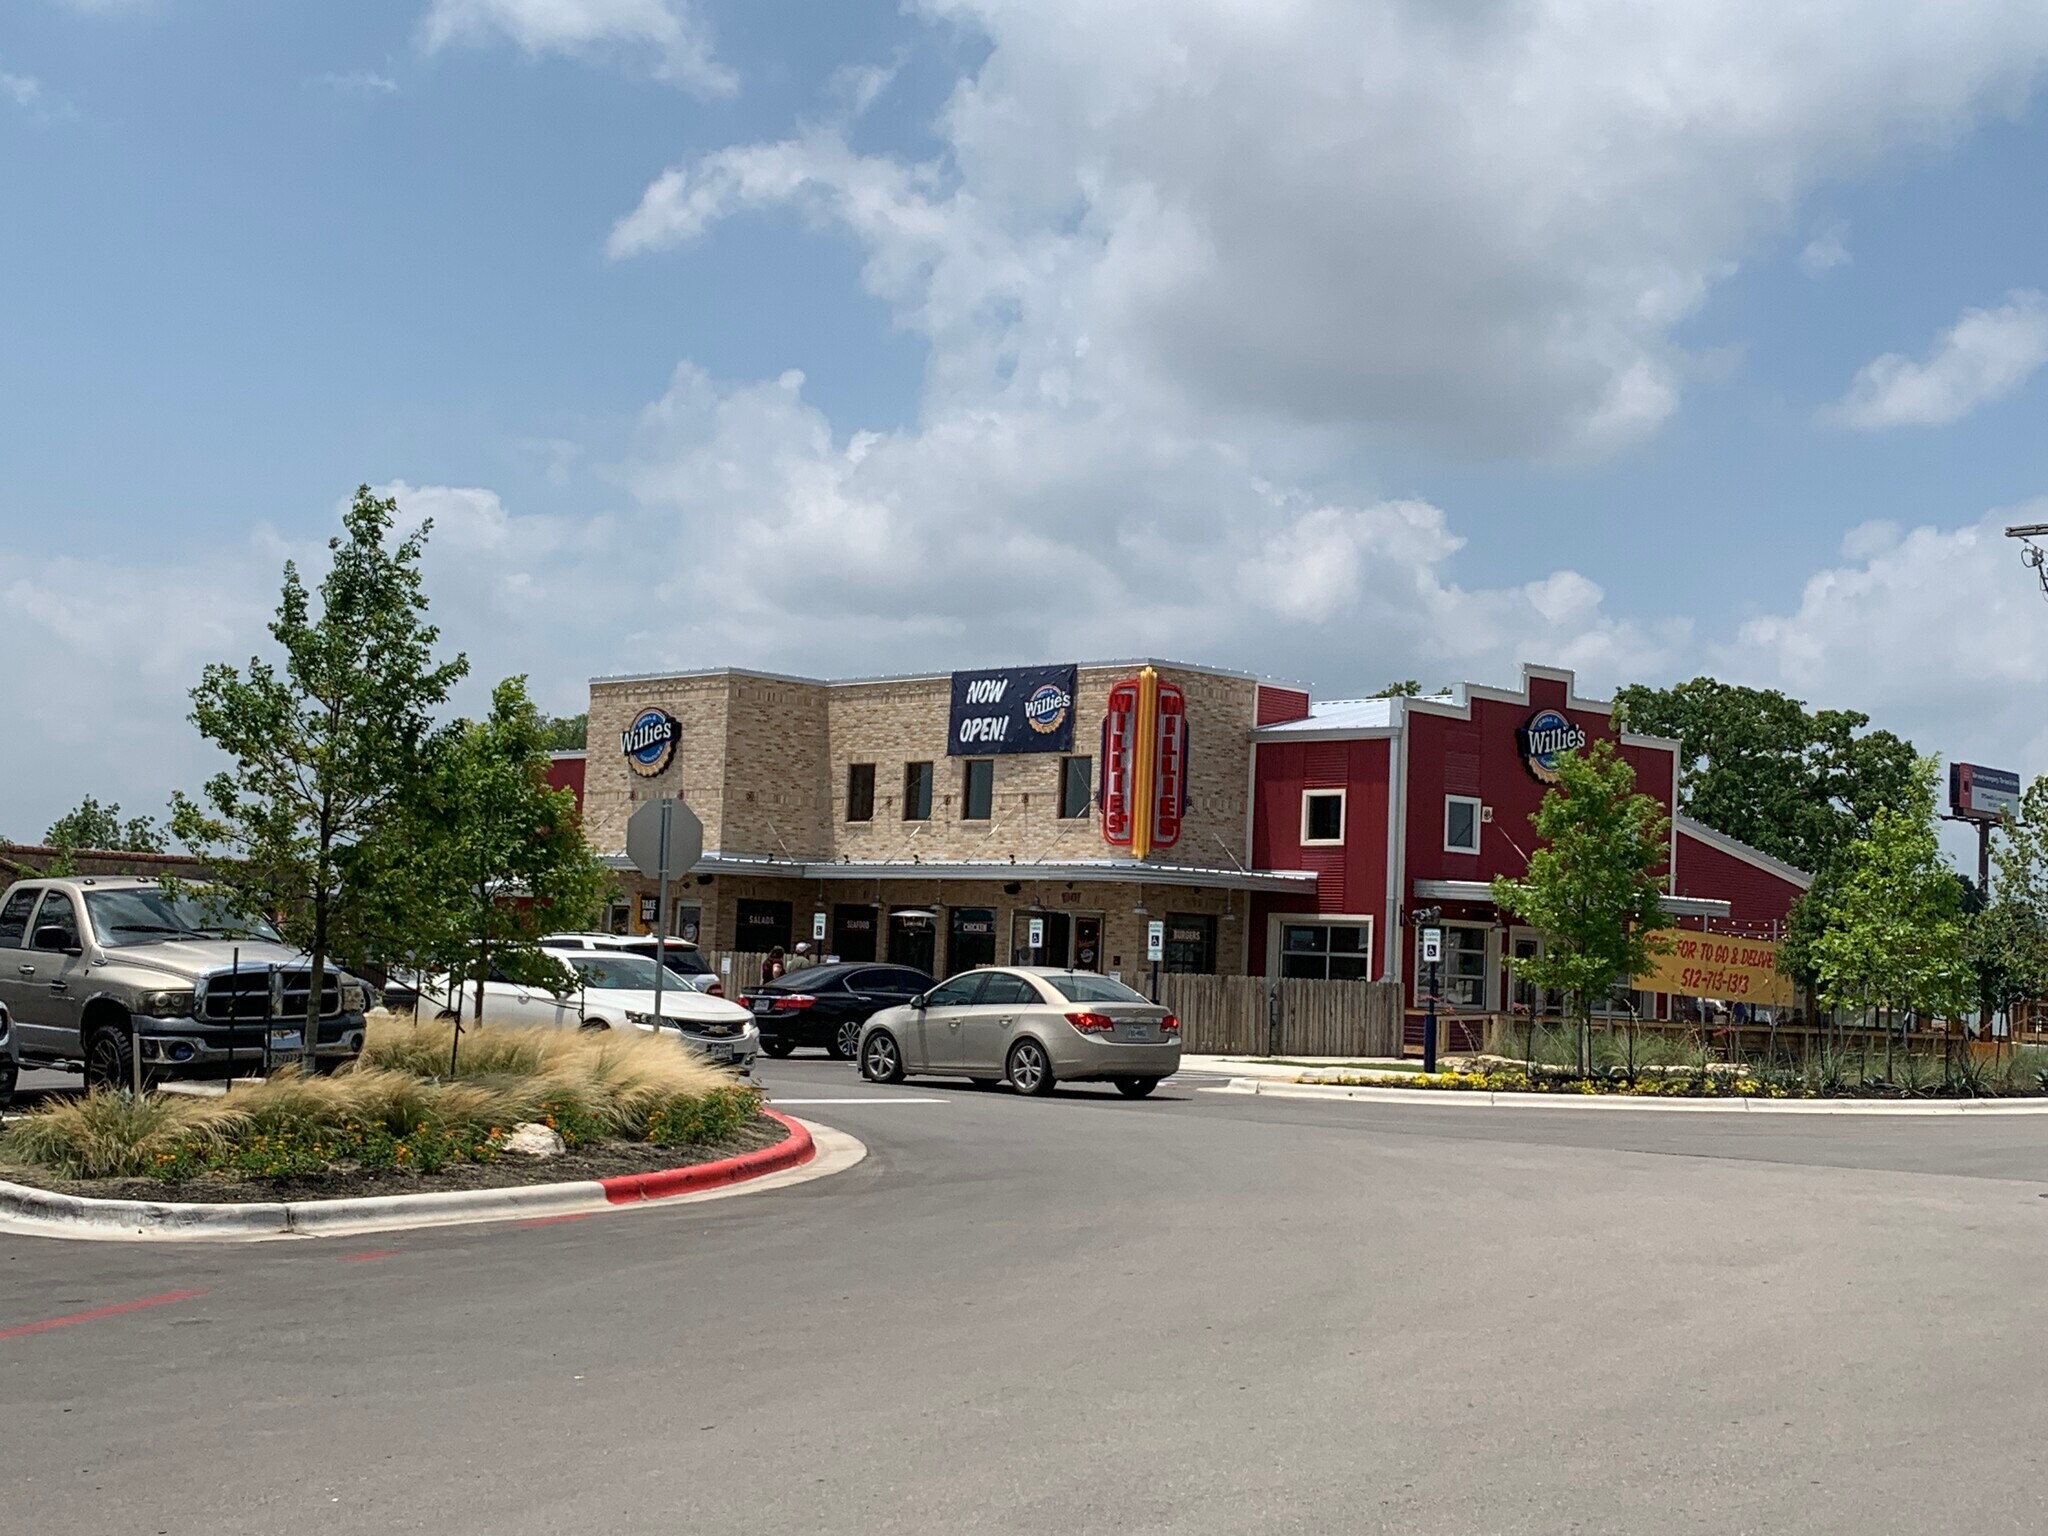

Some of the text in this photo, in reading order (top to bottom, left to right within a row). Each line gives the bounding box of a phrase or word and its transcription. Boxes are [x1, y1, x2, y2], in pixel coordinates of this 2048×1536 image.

[966, 679, 1008, 704] NOW
[1024, 691, 1071, 718] Willie's
[619, 719, 672, 753] Willie's
[960, 715, 1010, 743] OPEN!
[1528, 724, 1586, 755] Willie's
[641, 899, 657, 910] TAKE
[641, 910, 655, 920] OUT
[749, 915, 775, 925] SALADS
[847, 920, 870, 929] SEAFOOD
[1173, 929, 1201, 941] BURGERS
[1677, 939, 1697, 959] FOR
[1700, 943, 1713, 961] TO
[1715, 945, 1728, 963] GO
[1730, 947, 1739, 965] &
[1681, 968, 1750, 994] 512-713-1313
